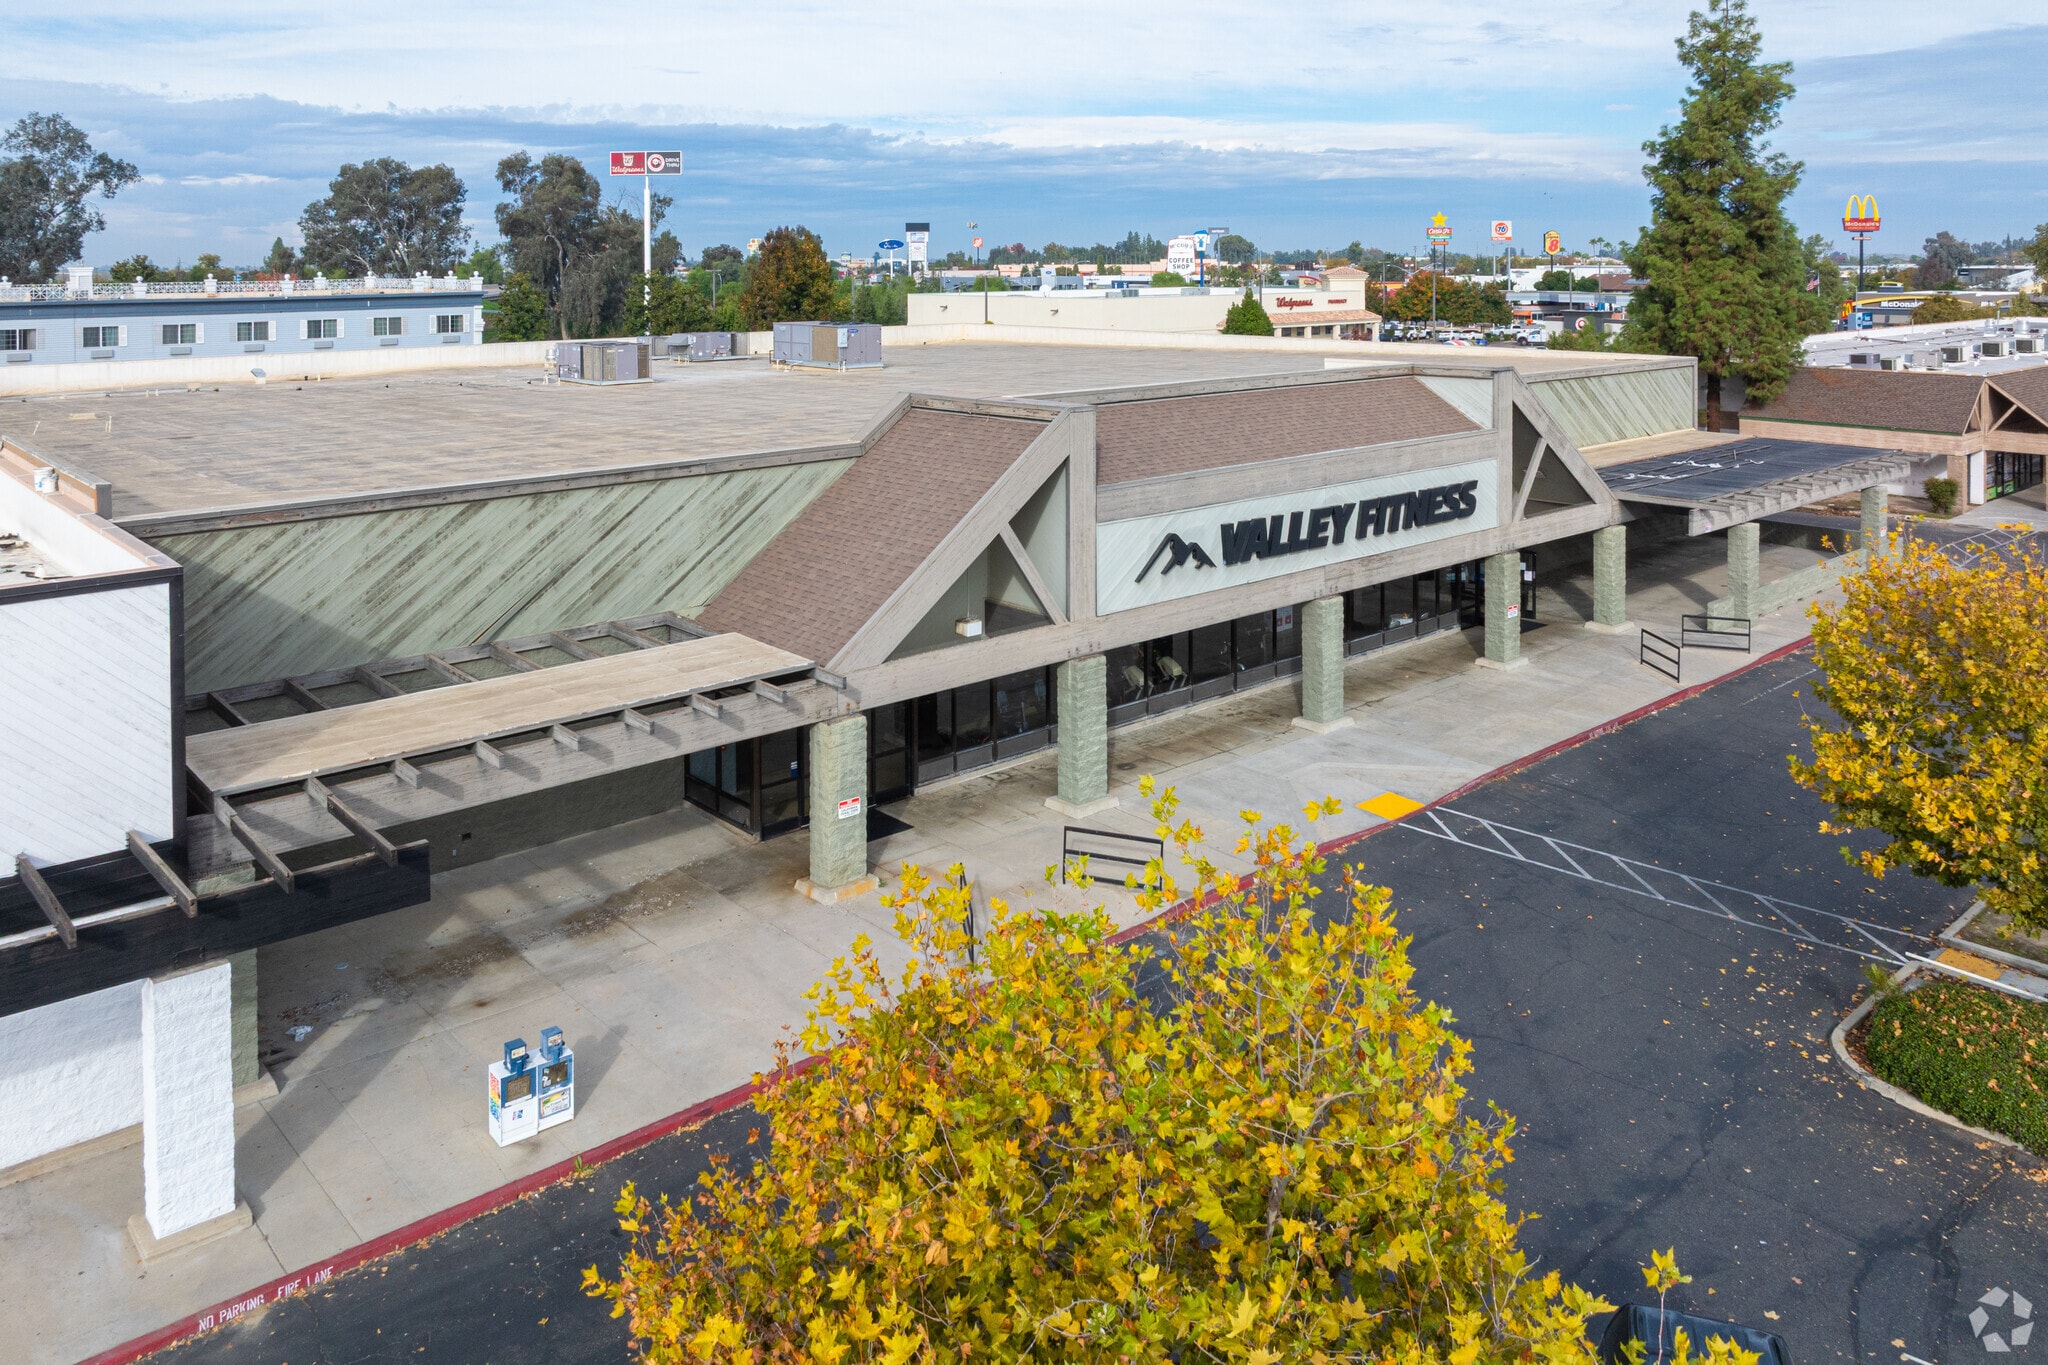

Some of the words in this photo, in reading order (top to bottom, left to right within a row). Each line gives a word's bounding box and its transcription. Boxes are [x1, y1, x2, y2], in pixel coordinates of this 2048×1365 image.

[1549, 238, 1559, 252] 8
[1220, 502, 1356, 566] VALLEY
[1355, 480, 1479, 540] FITNESS
[198, 1315, 214, 1332] NO
[219, 1294, 265, 1323] PARKING
